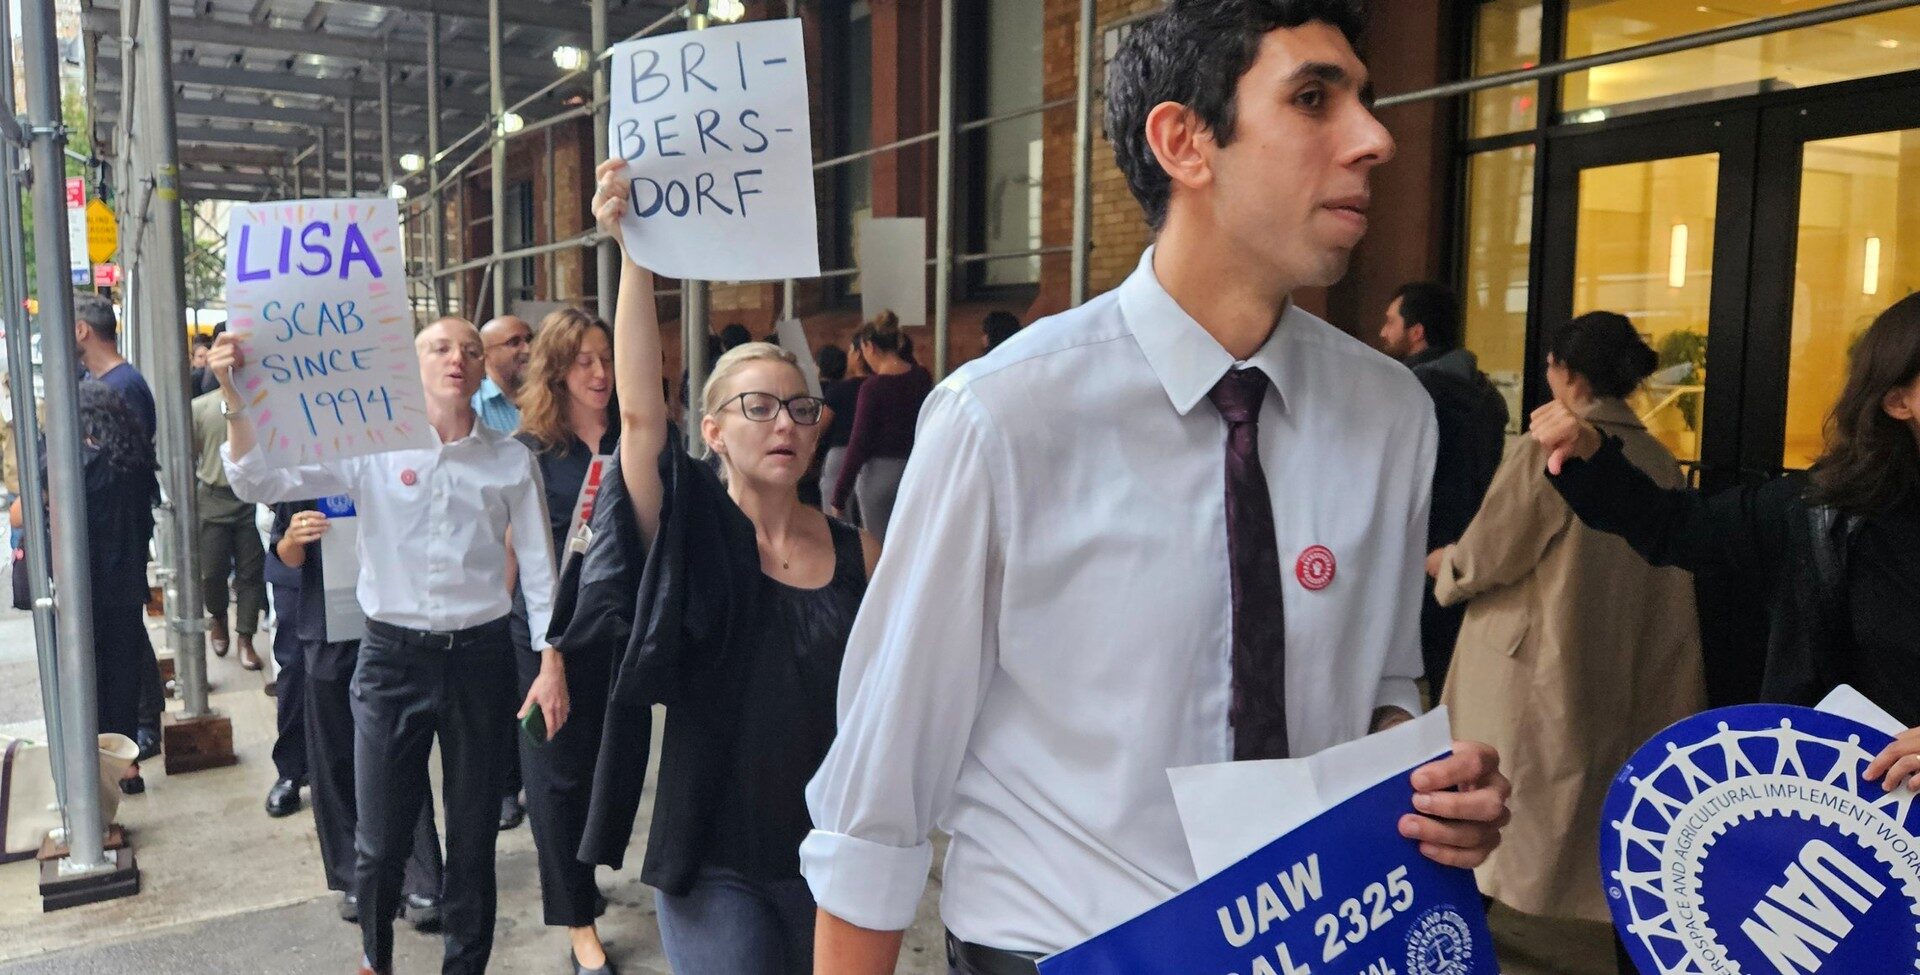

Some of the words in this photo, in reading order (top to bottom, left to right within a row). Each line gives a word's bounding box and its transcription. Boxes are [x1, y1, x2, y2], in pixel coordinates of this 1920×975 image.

[631, 41, 787, 104] BRI-
[617, 109, 793, 161] BERS-
[630, 169, 763, 217] DORF
[237, 221, 383, 282] LISA
[262, 300, 364, 342] SCAB
[262, 347, 380, 384] SINCE
[299, 386, 401, 437] 1994
[1674, 784, 1762, 861] AGRICULTURAL
[1763, 783, 1877, 826] IMPLEMENT
[1671, 862, 1687, 898] AND
[1876, 822, 1920, 882] WORK
[1216, 852, 1324, 948] UAW
[1314, 864, 1415, 964] 2325
[1740, 838, 1887, 975] UAW
